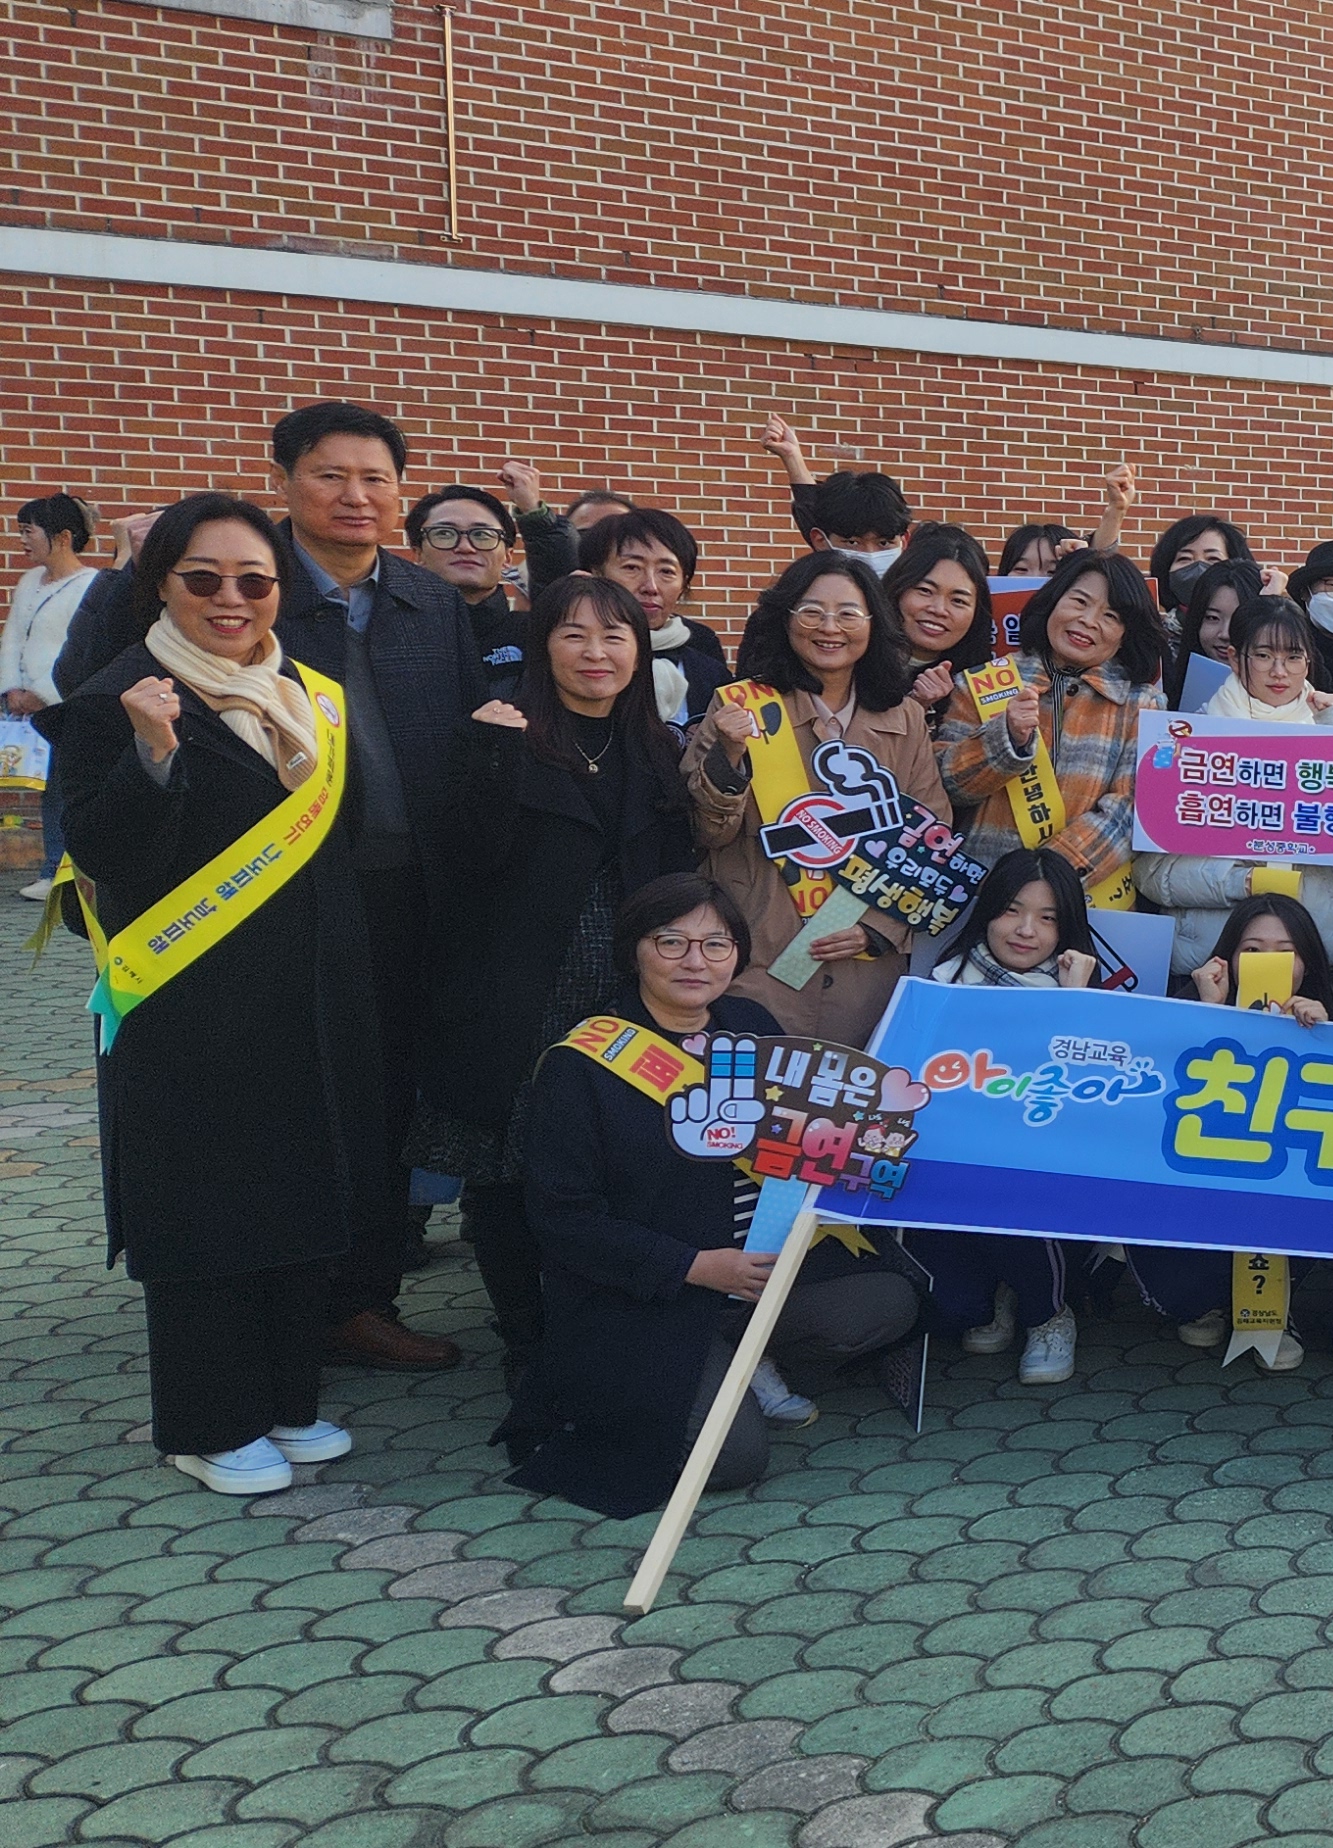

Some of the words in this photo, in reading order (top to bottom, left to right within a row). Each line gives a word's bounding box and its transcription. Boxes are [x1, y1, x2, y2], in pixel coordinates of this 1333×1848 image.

[974, 670, 1015, 694] NO
[980, 689, 1019, 705] SMOKING
[1179, 750, 1285, 787] 금연하면
[797, 808, 813, 826] NO
[807, 819, 844, 855] SMOKING
[1177, 792, 1283, 829] 흡연하면
[898, 804, 988, 884] 금연하면
[214, 843, 284, 902] 나도피해
[884, 846, 954, 896] 우리모두
[838, 853, 960, 936] 평생행복
[147, 896, 218, 956] 남도피해
[570, 1018, 621, 1054] NO
[603, 1027, 637, 1062] SMOKING
[1051, 1037, 1128, 1067] 경남교육
[764, 1046, 812, 1088] 내
[807, 1050, 877, 1108] 몸은
[924, 1051, 1163, 1124] 아이좋아
[707, 1126, 736, 1141] NO!
